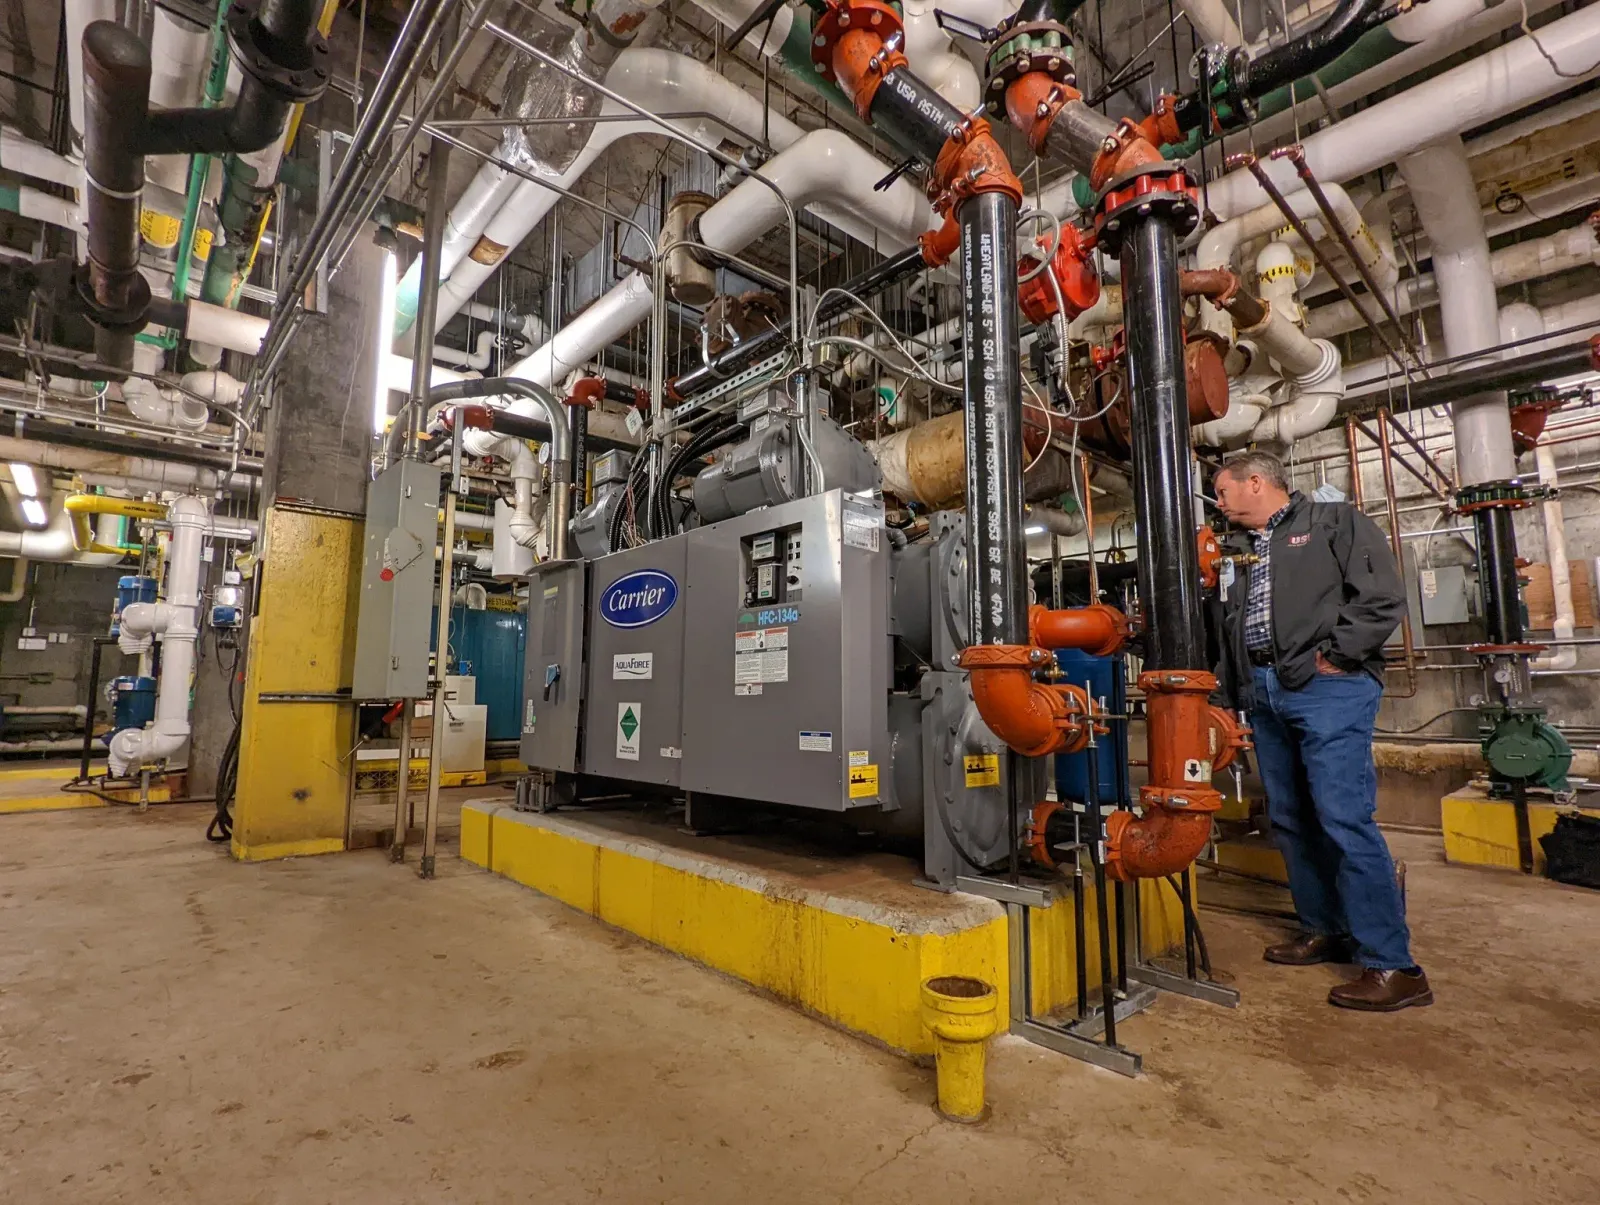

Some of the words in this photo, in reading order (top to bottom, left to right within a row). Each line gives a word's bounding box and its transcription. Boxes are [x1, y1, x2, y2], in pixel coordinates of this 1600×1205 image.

[896, 80, 917, 104] USA
[917, 98, 945, 125] ASTM
[982, 338, 994, 361] SCH
[983, 365, 995, 381] 40
[984, 384, 996, 408] USA
[984, 412, 997, 443] ASTM
[985, 447, 998, 505] A53/ASME
[988, 510, 1001, 543] SA53
[989, 546, 1001, 564] GR
[990, 567, 1002, 586] BE
[609, 584, 666, 612] Carrier
[758, 607, 798, 626] HFC-134a
